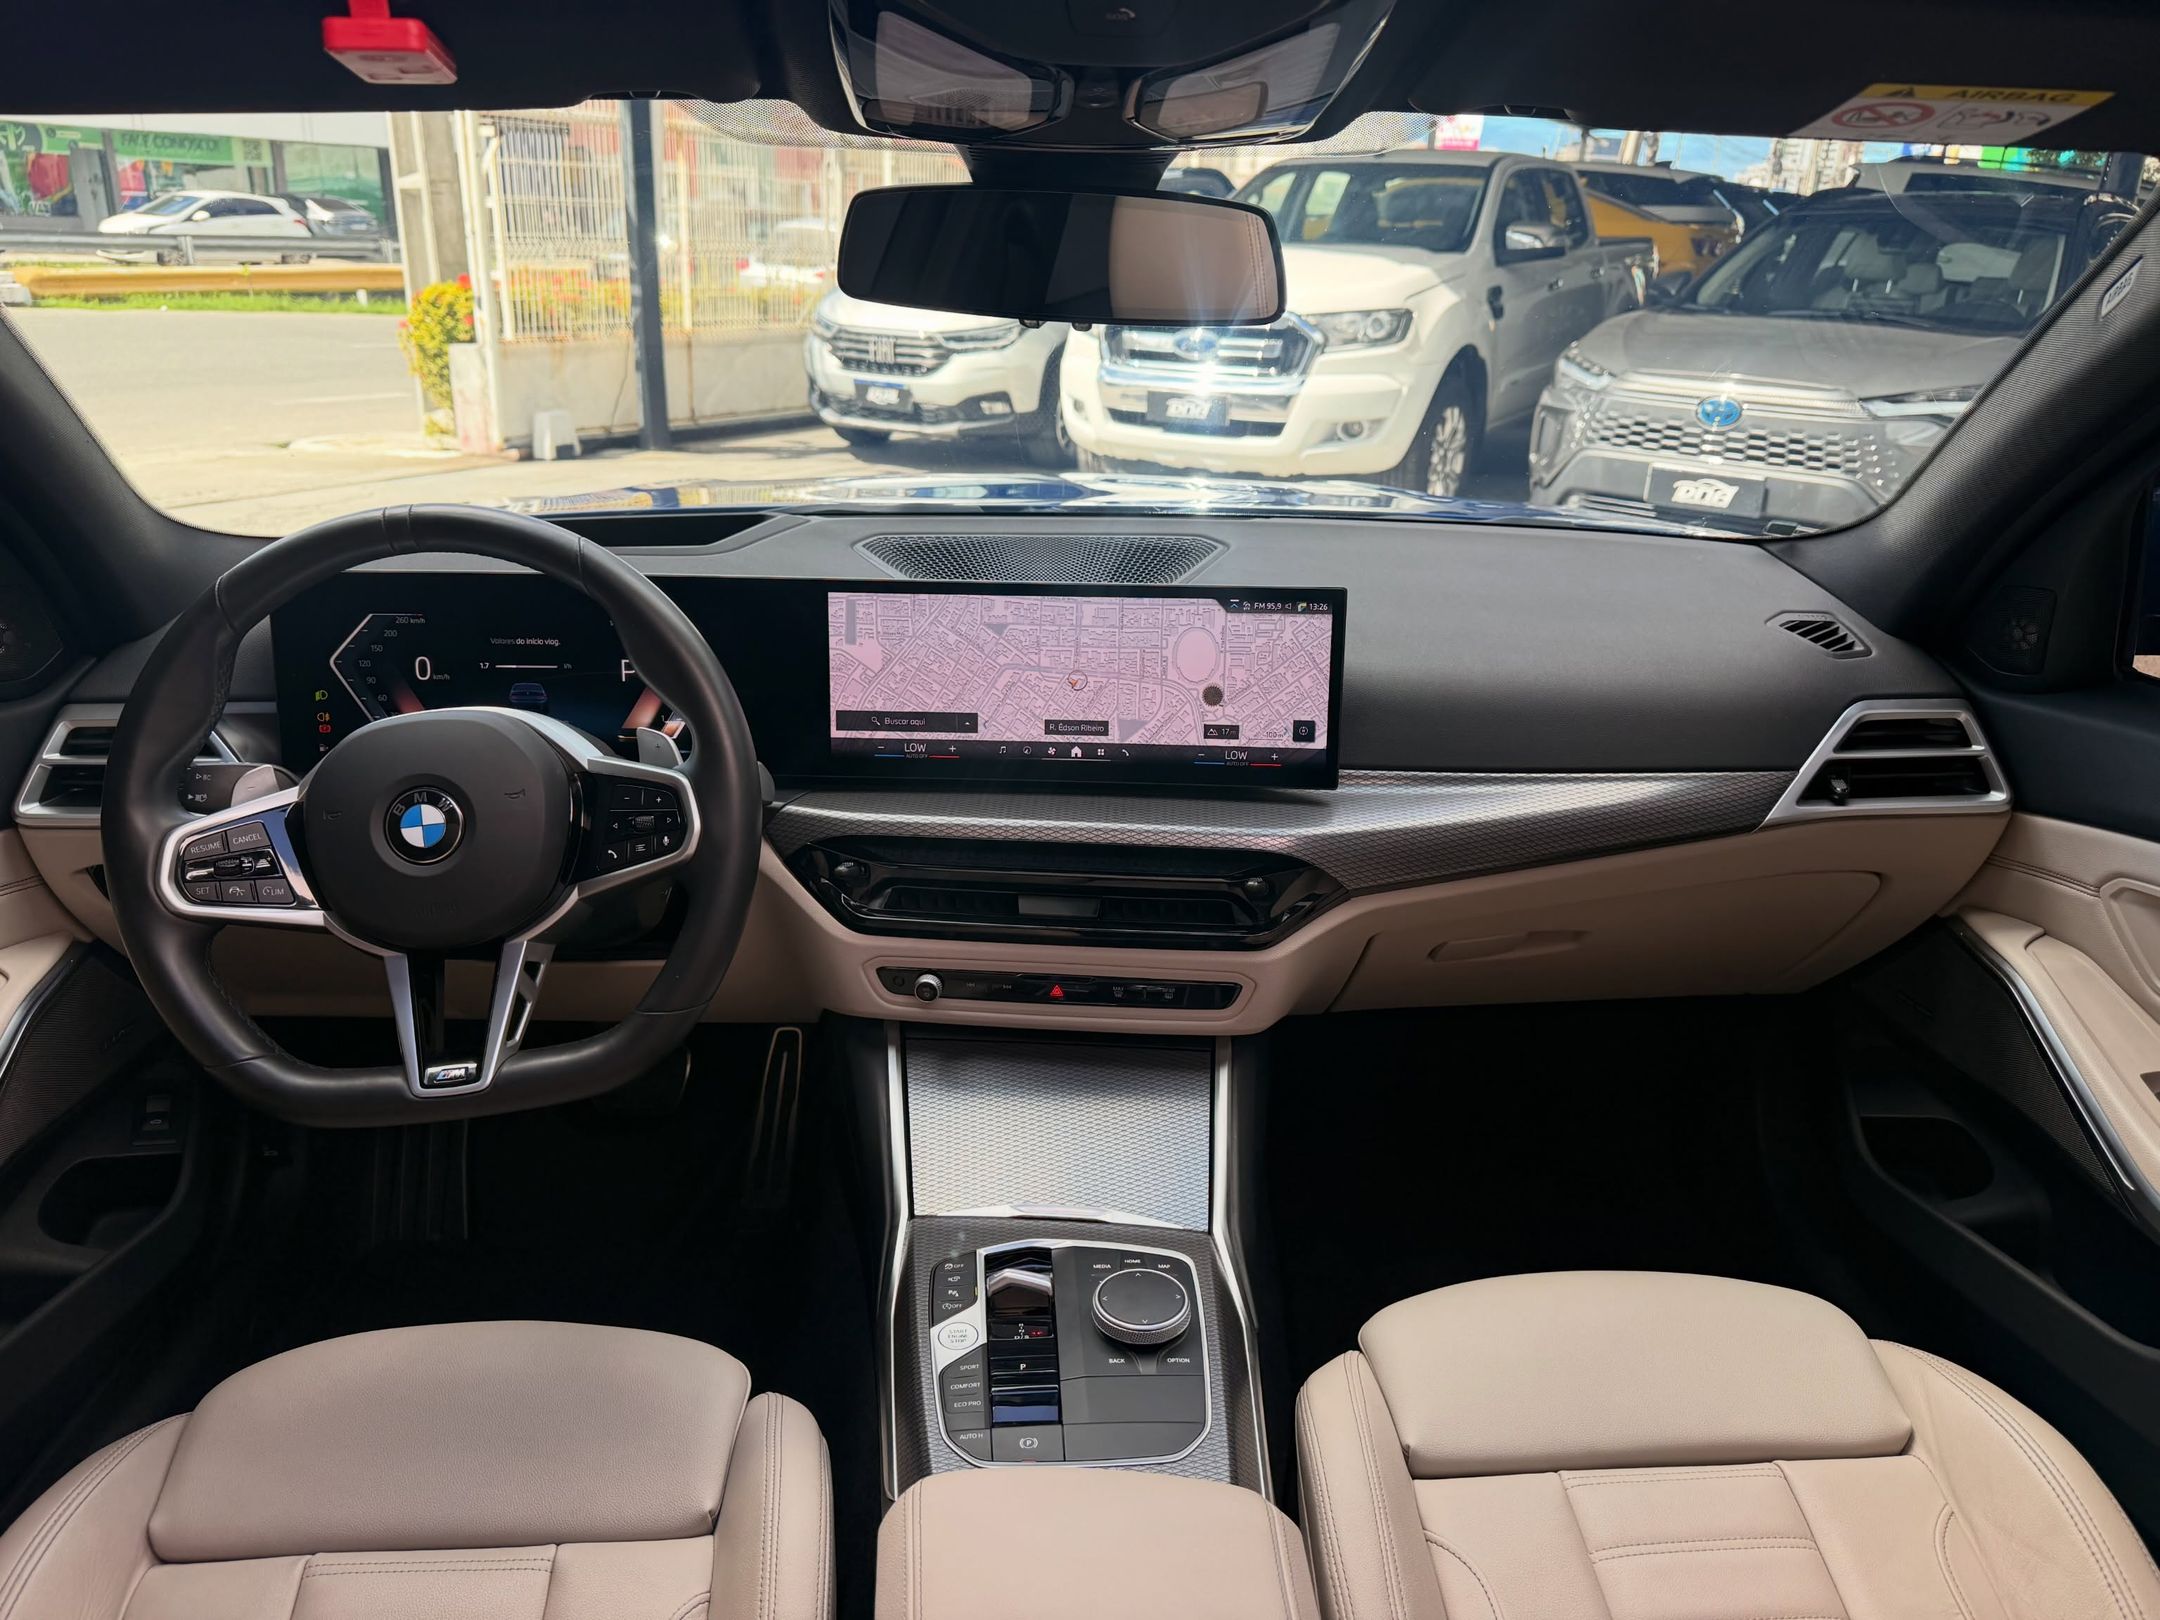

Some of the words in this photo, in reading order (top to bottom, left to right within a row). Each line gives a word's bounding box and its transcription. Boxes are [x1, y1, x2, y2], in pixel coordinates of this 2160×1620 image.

[1951, 88, 2079, 102] AIRBAG
[1254, 602, 1266, 610] FM
[1266, 602, 1282, 611] 95,9
[1309, 603, 1328, 611] 13:26
[395, 616, 409, 625] 260
[383, 629, 398, 638] 200
[515, 637, 525, 645] do
[370, 644, 383, 653] 150
[358, 659, 372, 668] 120
[414, 655, 432, 681] 0
[432, 672, 451, 682] km/h
[366, 676, 376, 685] 90
[377, 693, 388, 702] 60
[884, 716, 908, 725] Buscar
[910, 718, 926, 726] aqui
[1049, 723, 1057, 731] R.
[1080, 723, 1105, 732] Ribeiro
[904, 743, 927, 752] LOW
[1225, 750, 1248, 760] LOW
[393, 792, 453, 816] BMW
[190, 841, 221, 855] RESUME
[232, 833, 262, 845] CANCEL
[195, 886, 210, 895] SET
[959, 1363, 980, 1371] SPORT
[1019, 1363, 1027, 1371] P
[950, 1381, 981, 1390] COMFORT
